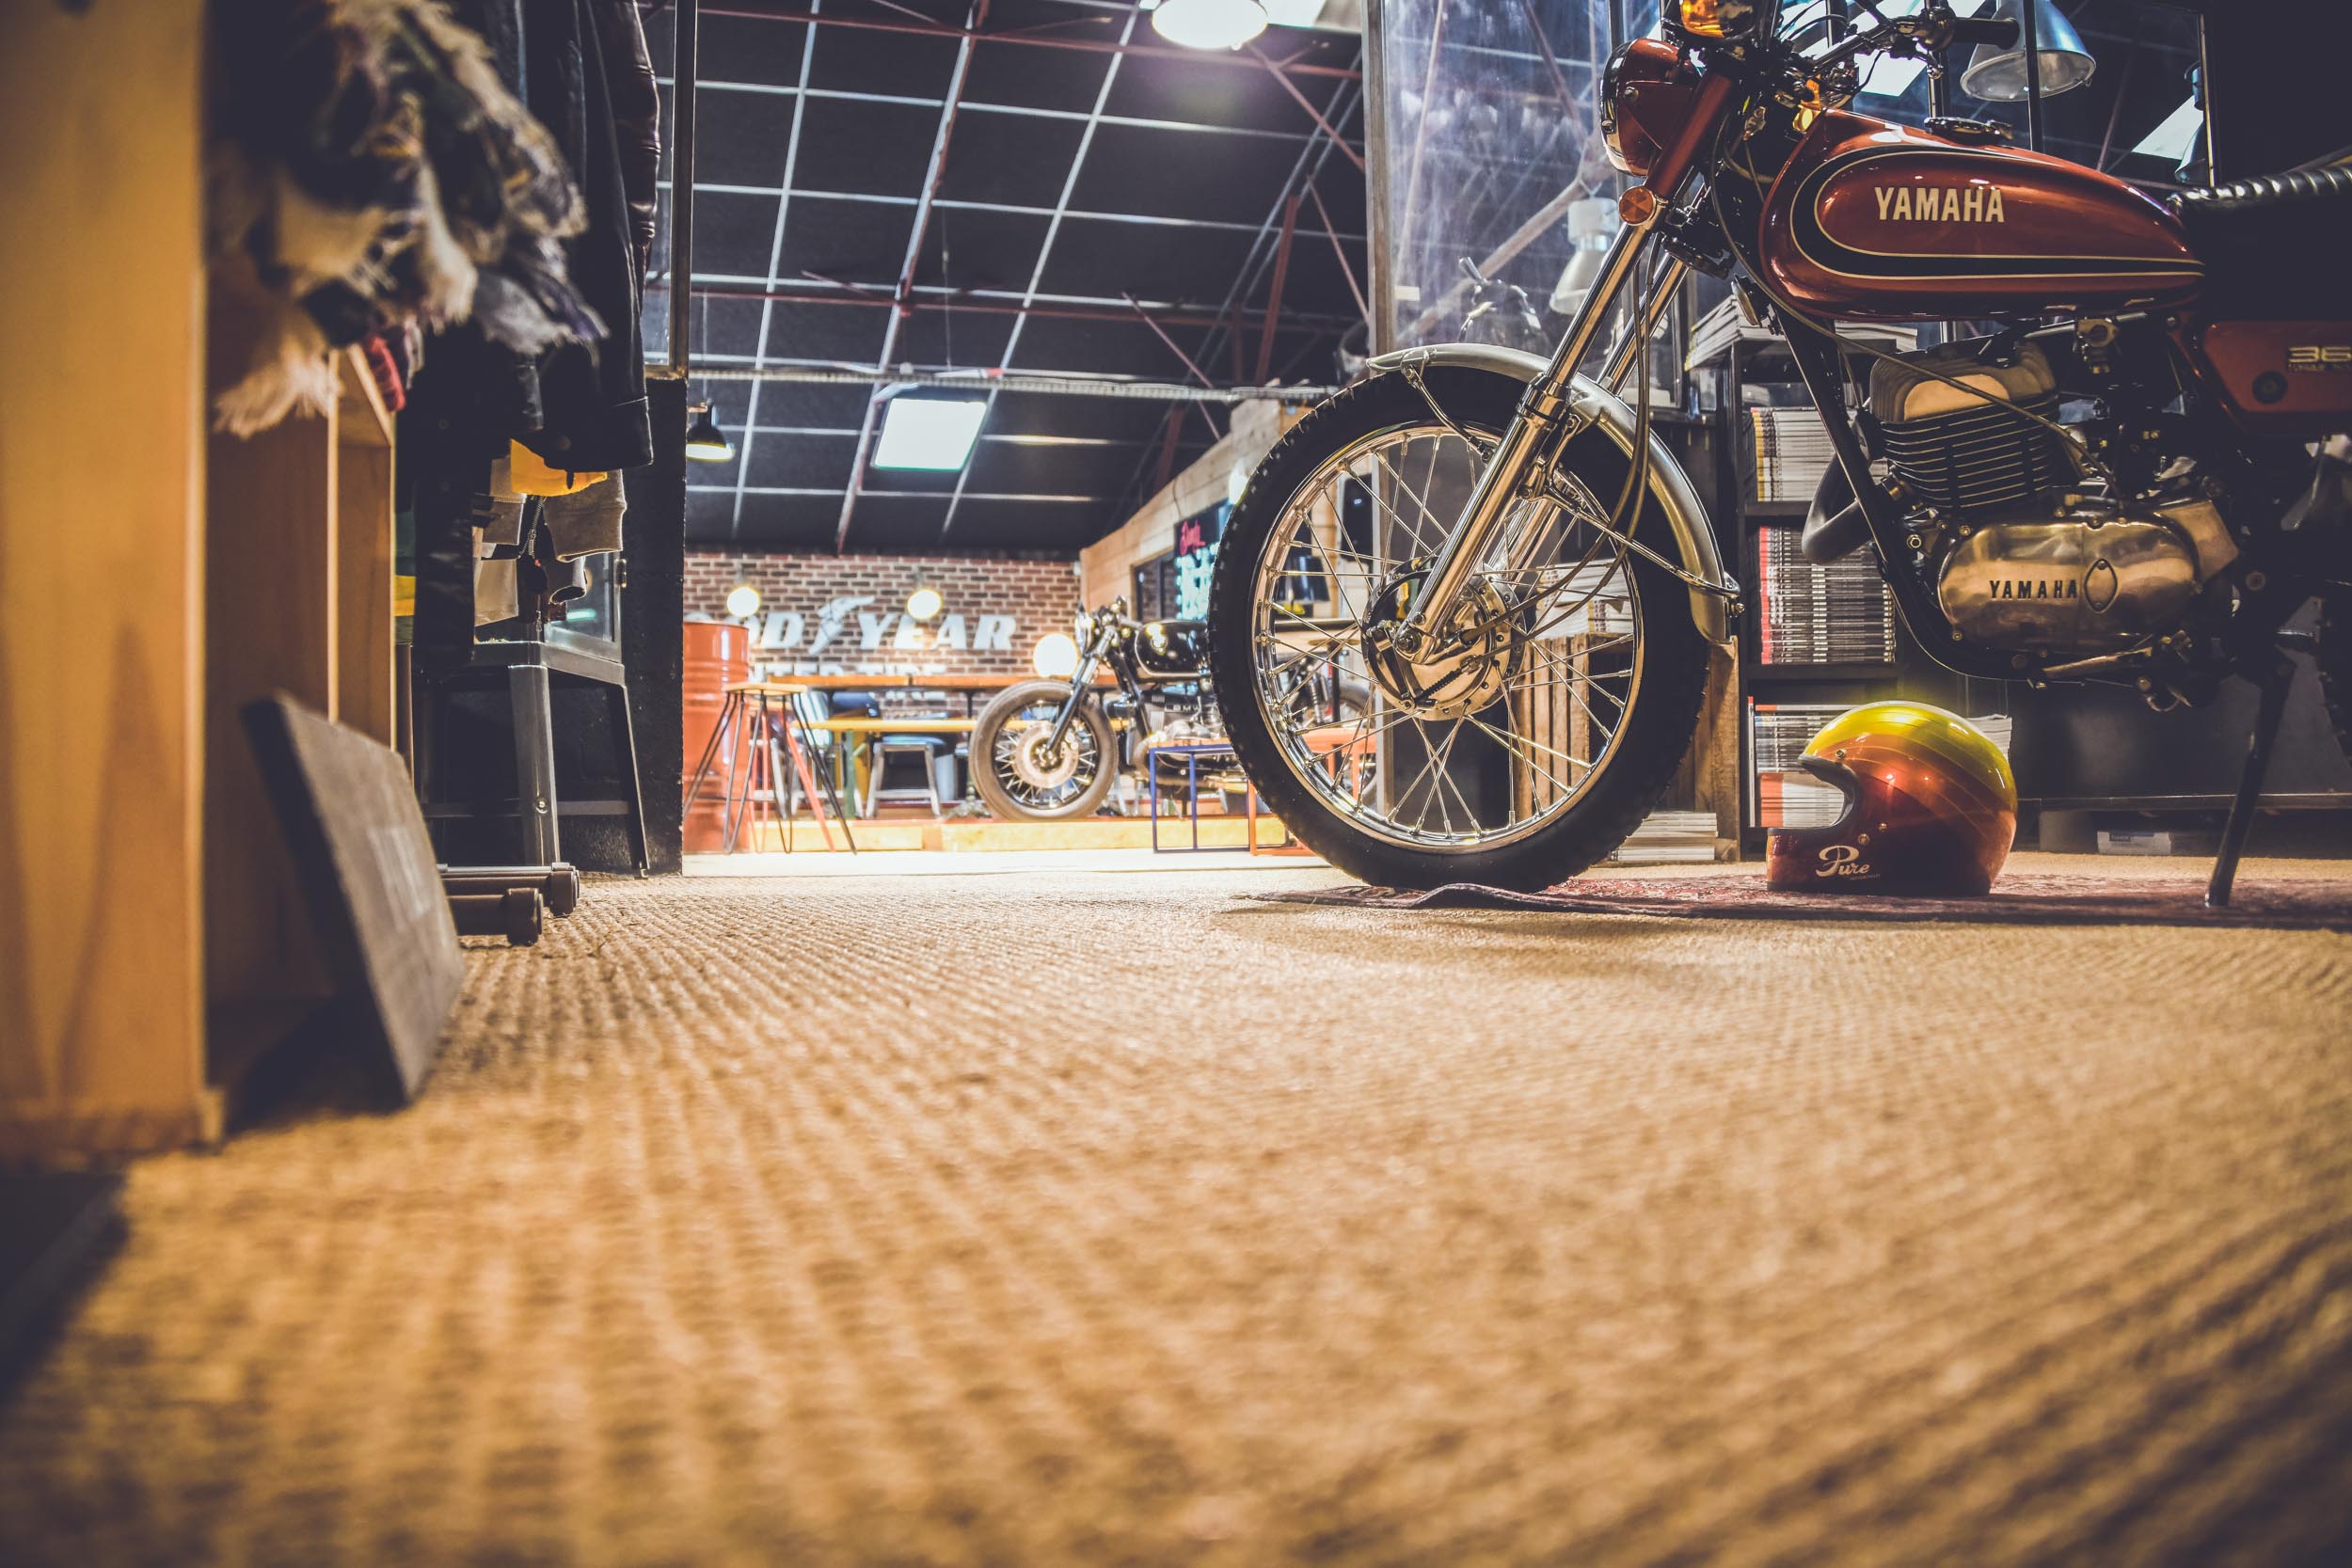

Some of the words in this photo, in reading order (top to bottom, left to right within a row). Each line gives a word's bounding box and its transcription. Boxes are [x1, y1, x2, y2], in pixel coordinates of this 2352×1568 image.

[1874, 186, 2005, 223] YAMAHA
[1989, 579, 2078, 599] YAMAHA
[1815, 845, 1870, 878] Pure
